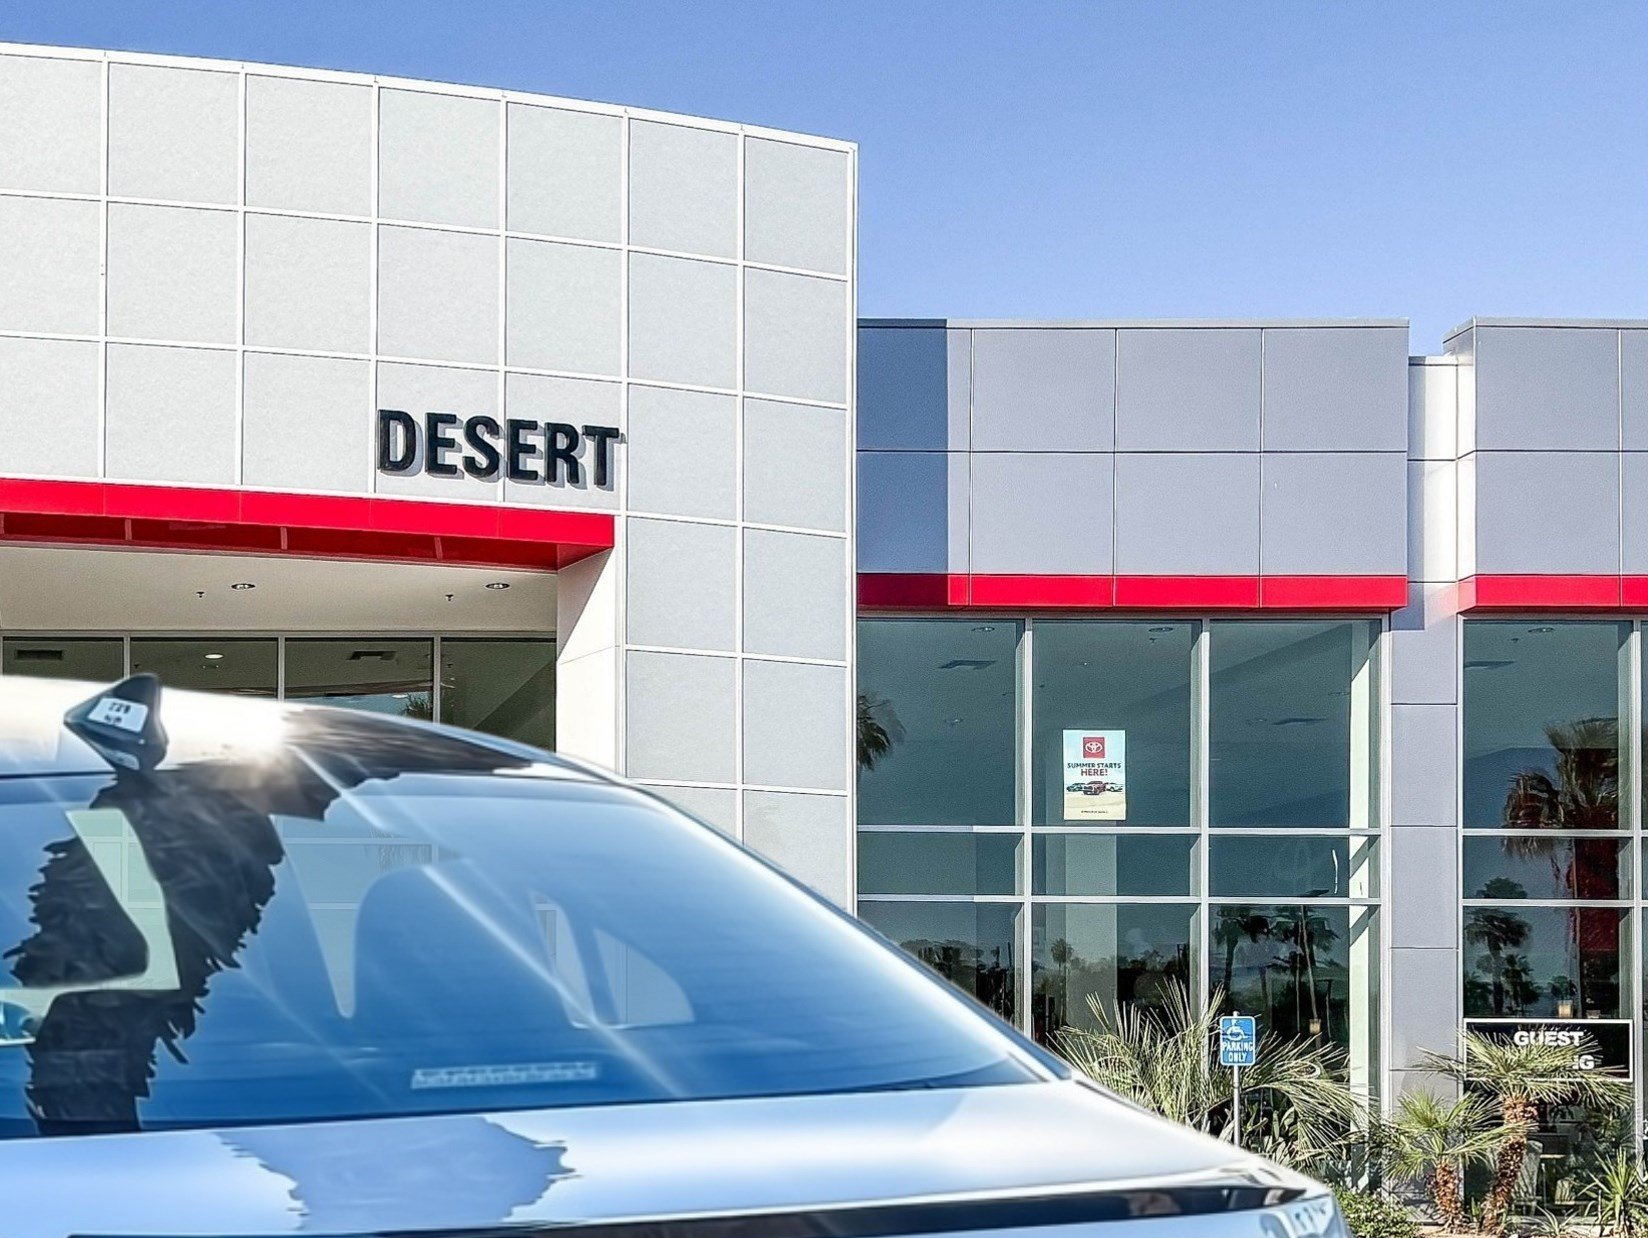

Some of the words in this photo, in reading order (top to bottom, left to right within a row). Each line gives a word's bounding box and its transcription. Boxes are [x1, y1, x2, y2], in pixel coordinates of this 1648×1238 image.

[377, 409, 620, 486] DESERT
[1081, 768, 1108, 777] HERE!
[1513, 1031, 1584, 1047] GUEST
[1222, 1041, 1254, 1051] PARKING
[1228, 1051, 1248, 1062] ONLY
